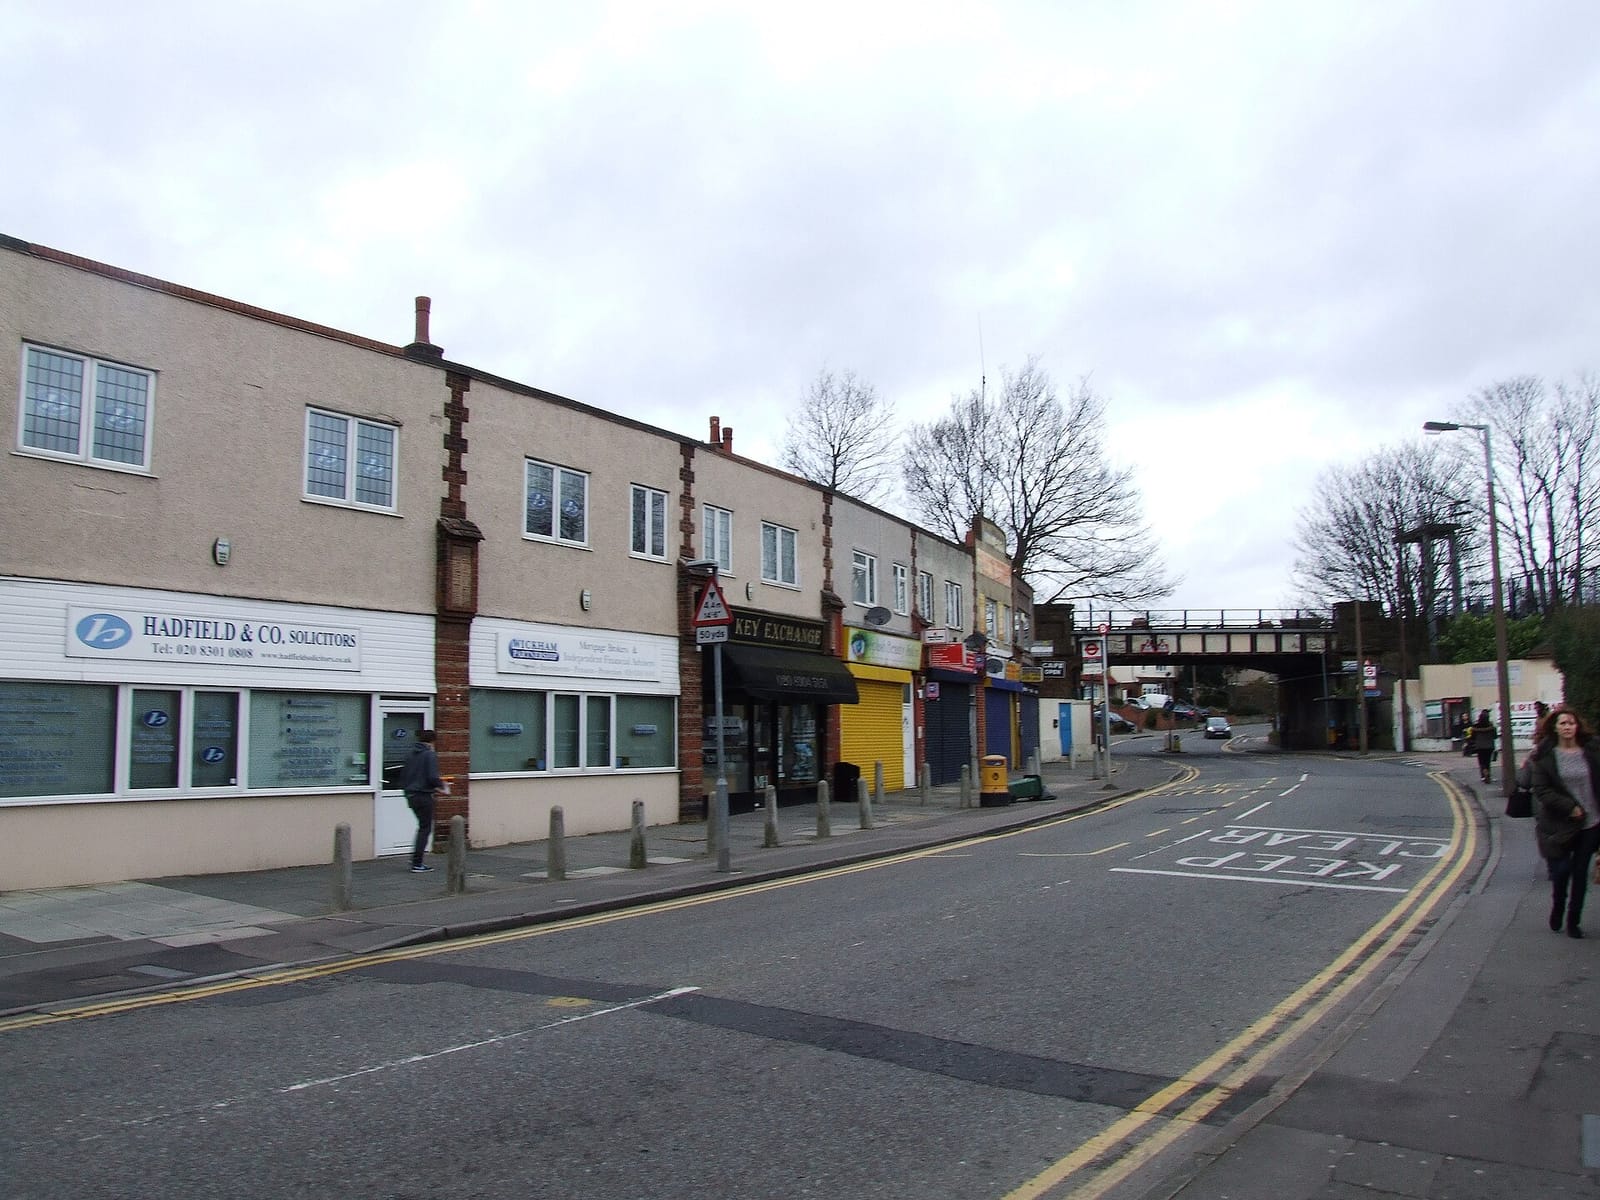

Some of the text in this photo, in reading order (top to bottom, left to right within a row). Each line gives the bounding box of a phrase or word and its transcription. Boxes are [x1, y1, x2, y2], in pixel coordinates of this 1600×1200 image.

[143, 616, 357, 648] HADFIELD & CO. SOLICITORS
[511, 639, 558, 651] WICKHAM
[735, 617, 822, 645] KEY EXCHANGE
[152, 642, 173, 654] Tel:
[176, 644, 197, 655] 020
[200, 646, 224, 657] 8301
[228, 647, 253, 659] 0808
[1208, 829, 1452, 858] CLEAR
[1175, 851, 1402, 881] KEEP
